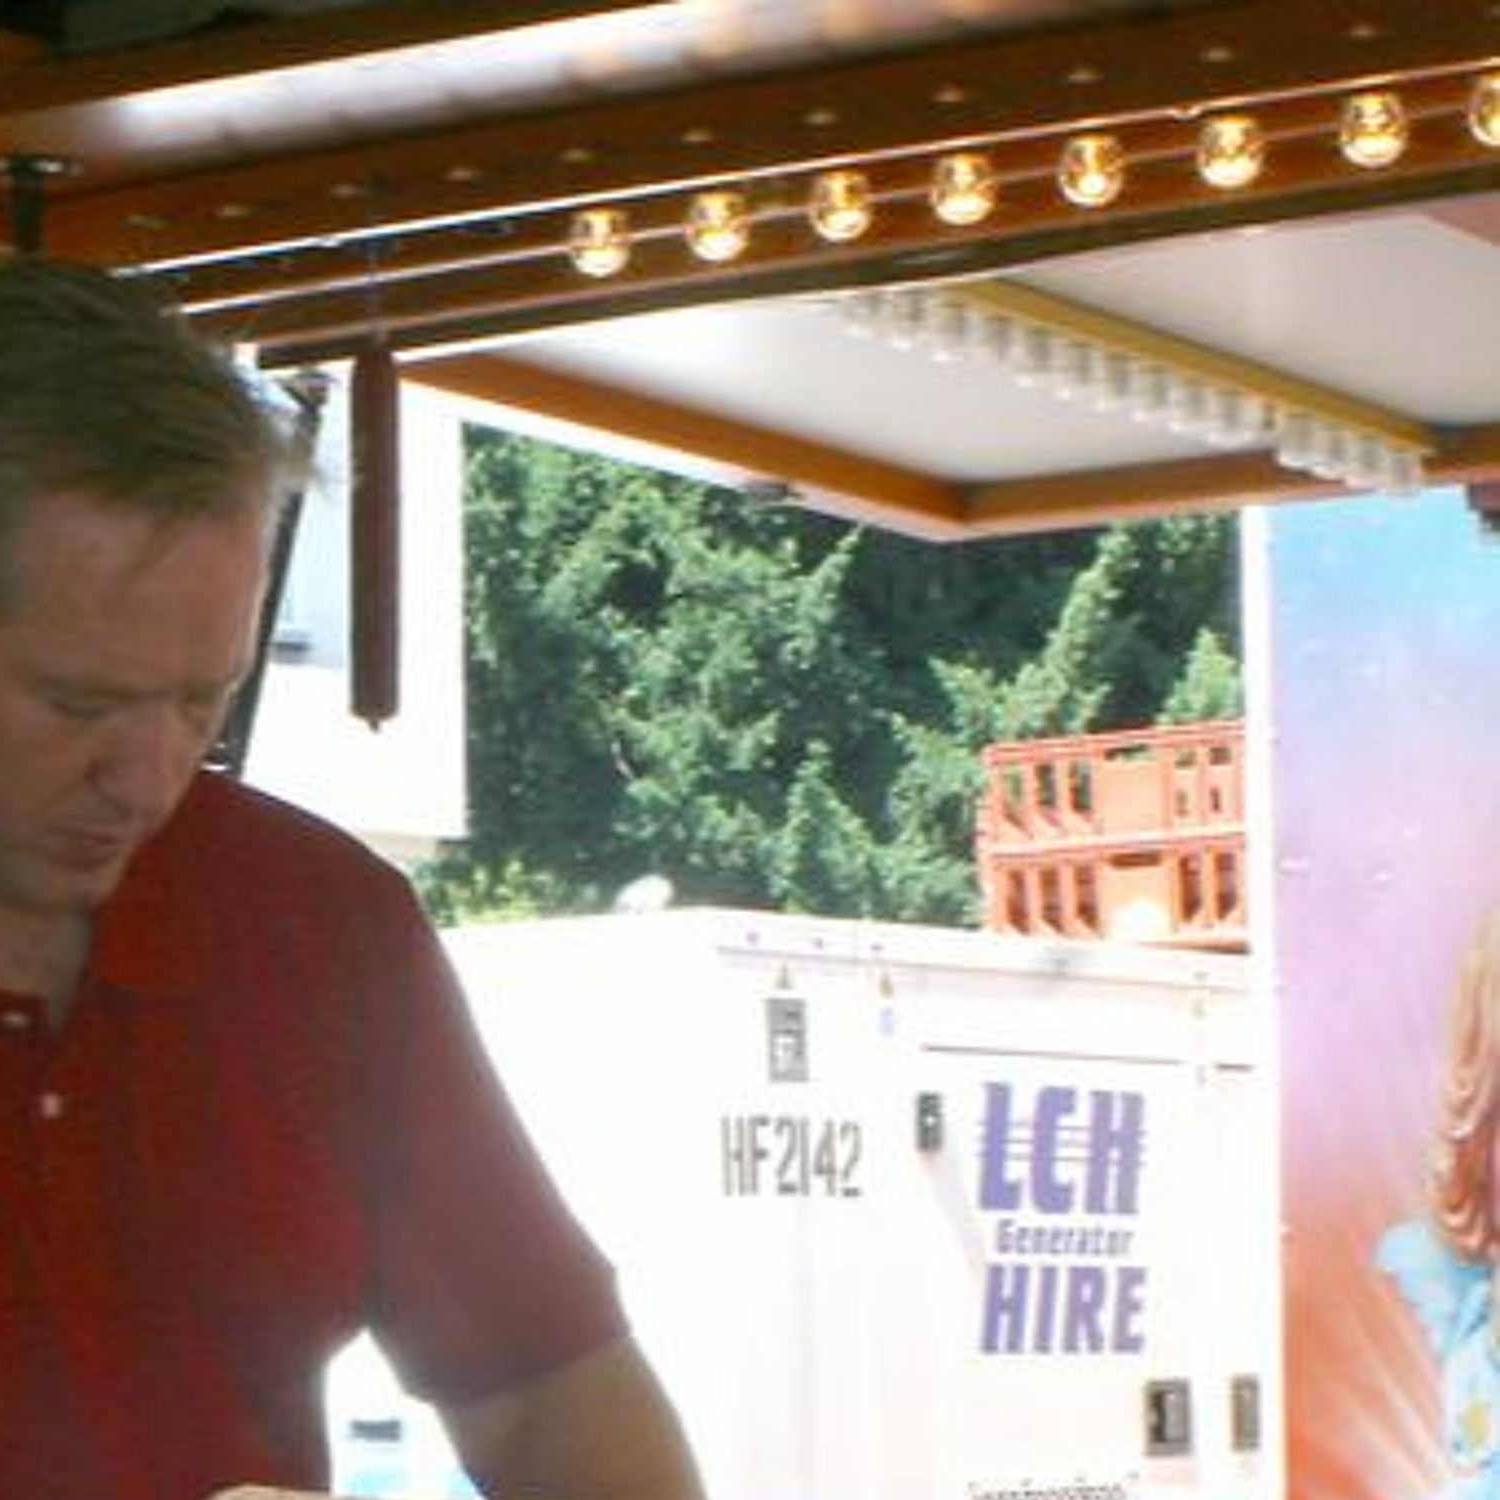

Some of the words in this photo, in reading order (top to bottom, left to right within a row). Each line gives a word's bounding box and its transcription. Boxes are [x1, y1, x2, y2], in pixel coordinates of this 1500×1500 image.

[977, 1081, 1147, 1215] LCH
[996, 1218, 1135, 1257] Generator
[979, 1263, 1148, 1355] HIRE
